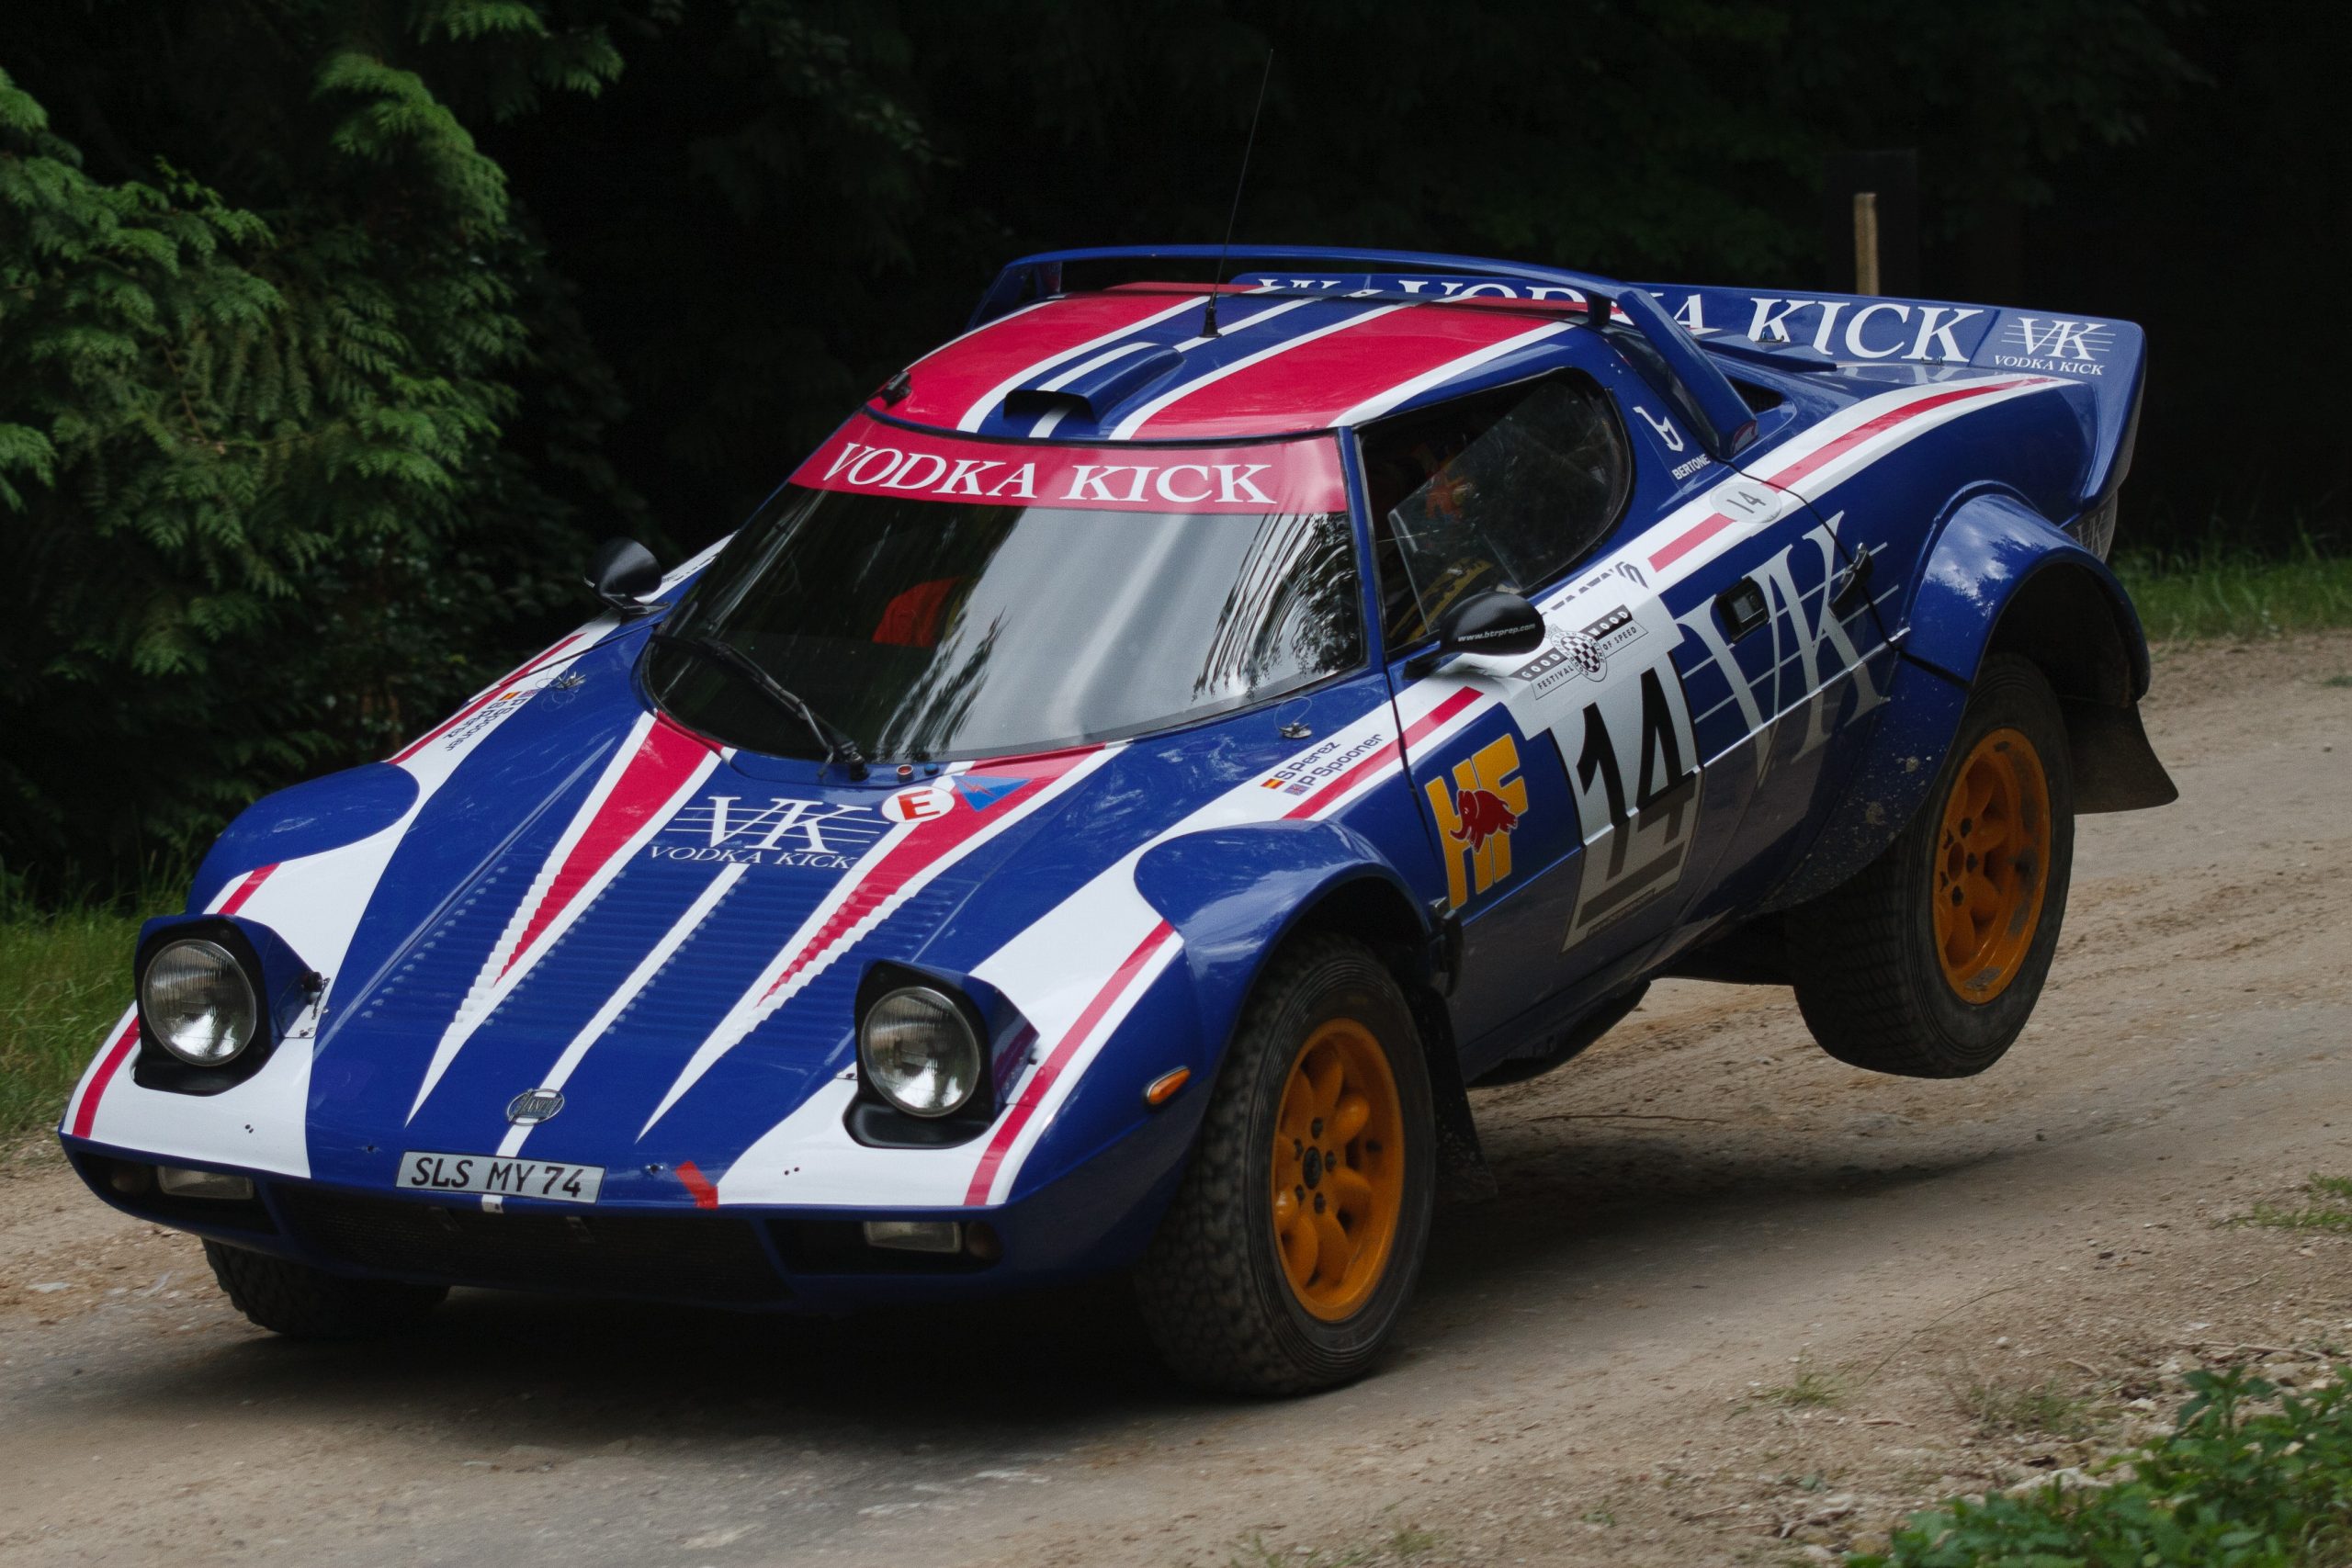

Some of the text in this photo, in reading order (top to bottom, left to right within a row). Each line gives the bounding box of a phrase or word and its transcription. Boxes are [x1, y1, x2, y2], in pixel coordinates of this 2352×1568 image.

[1747, 297, 1984, 363] KICK
[2018, 317, 2107, 361] VK
[1994, 355, 2106, 376] VODKA KICK
[821, 442, 1277, 504] VODKA KICK
[1671, 453, 1711, 480] BERTONE
[1726, 491, 1767, 514] 14
[1457, 623, 1536, 642] www.btrprep.com
[1521, 610, 1629, 679] GOOD WOOD
[1536, 626, 1637, 690] FESTIVAL OF SPEED
[1273, 741, 1340, 781] S Perez
[1297, 733, 1384, 786] P Spooner
[1578, 666, 1686, 883] 14
[707, 795, 873, 853] VK
[898, 789, 941, 820] E
[1424, 733, 1529, 910] HF
[649, 844, 857, 869] VODKA KICK
[412, 1156, 584, 1198] SLS MY 74
